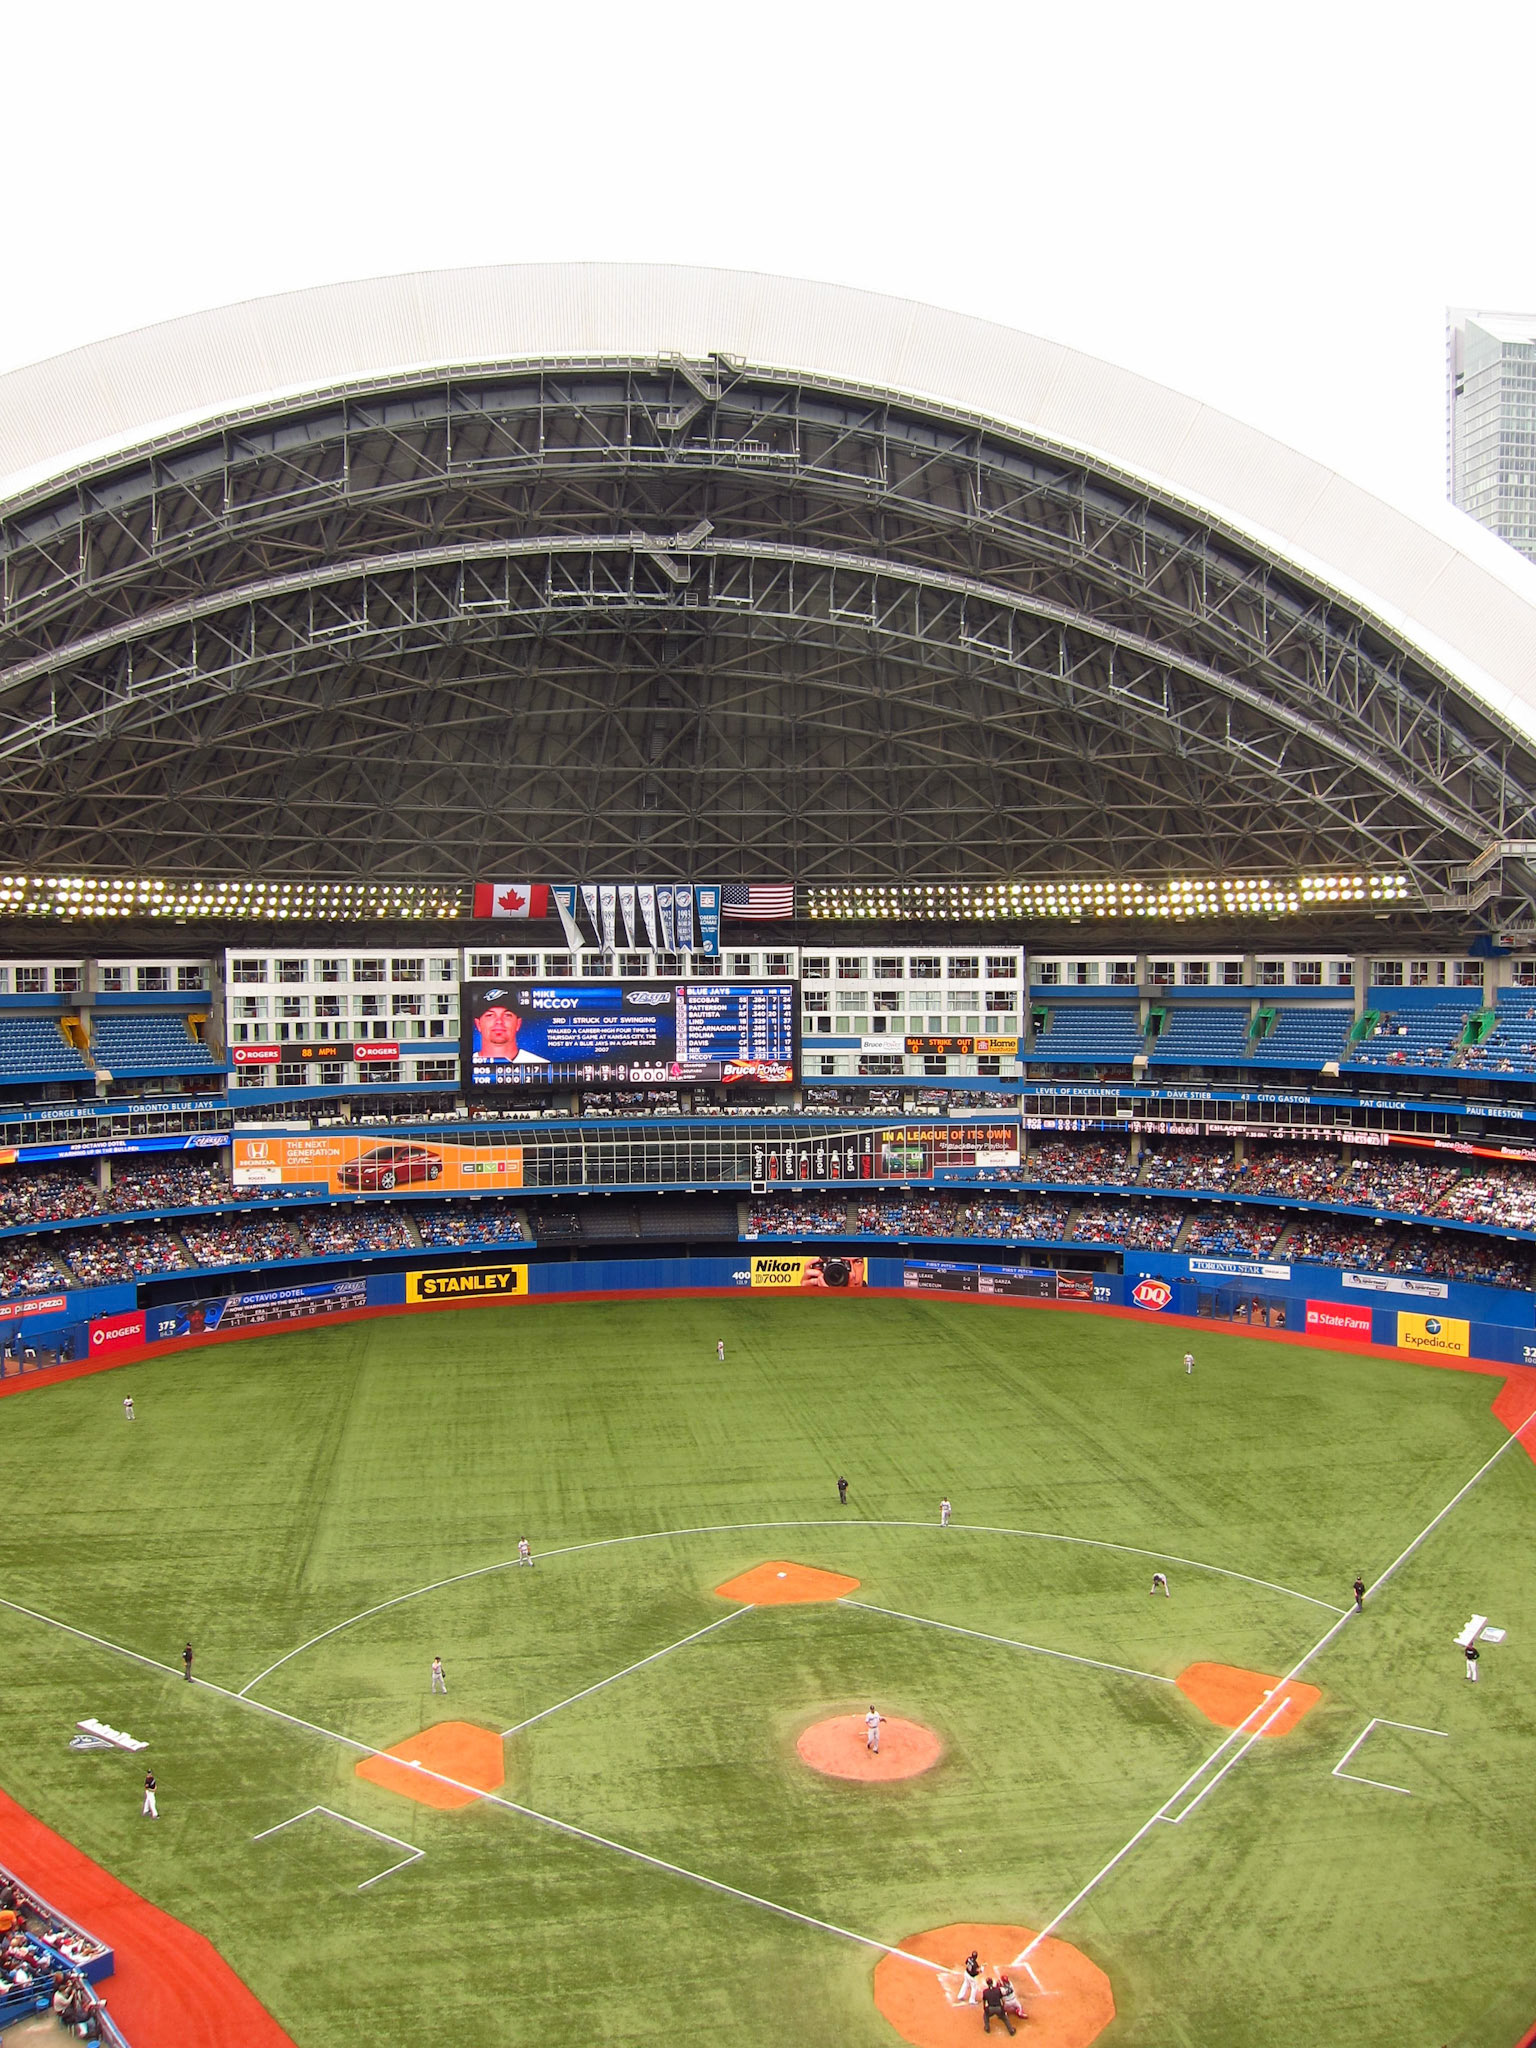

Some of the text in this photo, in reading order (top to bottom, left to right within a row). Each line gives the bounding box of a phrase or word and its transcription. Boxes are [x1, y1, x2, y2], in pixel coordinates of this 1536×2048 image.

[533, 999, 579, 1009] MCCOY
[912, 1046, 918, 1054] 0
[938, 1046, 944, 1054] 0
[990, 1040, 1016, 1048] Home
[724, 1064, 787, 1074] Bruce Power
[41, 1109, 75, 1118] GEORGE
[77, 1108, 96, 1117] BELL
[128, 1104, 170, 1112] TORONTO
[172, 1102, 192, 1110] BLUE
[194, 1101, 213, 1109] JAYS
[1072, 1088, 1120, 1096] EXCELLENCE
[1167, 1090, 1188, 1098] DAVE
[1257, 1094, 1276, 1102] CITO
[1278, 1095, 1311, 1104] GASTON
[1376, 1100, 1406, 1109] GILLICK
[1466, 1107, 1485, 1116] PAUL
[1488, 1110, 1524, 1119] BEESTON
[882, 1130, 1012, 1141] IN A LEAGUE OF ITS OWN
[947, 1143, 983, 1151] BlackBerry
[1434, 1140, 1454, 1148] Bruce
[1500, 1146, 1521, 1154] Bruce
[58, 1150, 86, 1158] WARMING
[286, 1148, 340, 1157] GENERATION
[784, 1140, 794, 1176] going...
[816, 1140, 824, 1175] going...
[754, 1144, 764, 1178] thirsty?
[846, 1146, 855, 1172] gone.
[756, 1260, 800, 1272] Nikon
[1196, 1262, 1260, 1274] TORONTO STAR
[732, 1272, 750, 1280] 400
[755, 1274, 792, 1284] D7000
[424, 1274, 510, 1294] STANLEY
[243, 1289, 304, 1304] OCTAVIO DOTEL
[1094, 1286, 1111, 1296] 375
[1140, 1286, 1166, 1304] DQ
[14, 1298, 63, 1315] pizza pizza
[244, 1302, 270, 1310] WARMING
[158, 1320, 176, 1332] 375
[1319, 1313, 1370, 1330] State Farm
[106, 1324, 141, 1340] ROGERS
[1404, 1332, 1461, 1350] Expedia.ca
